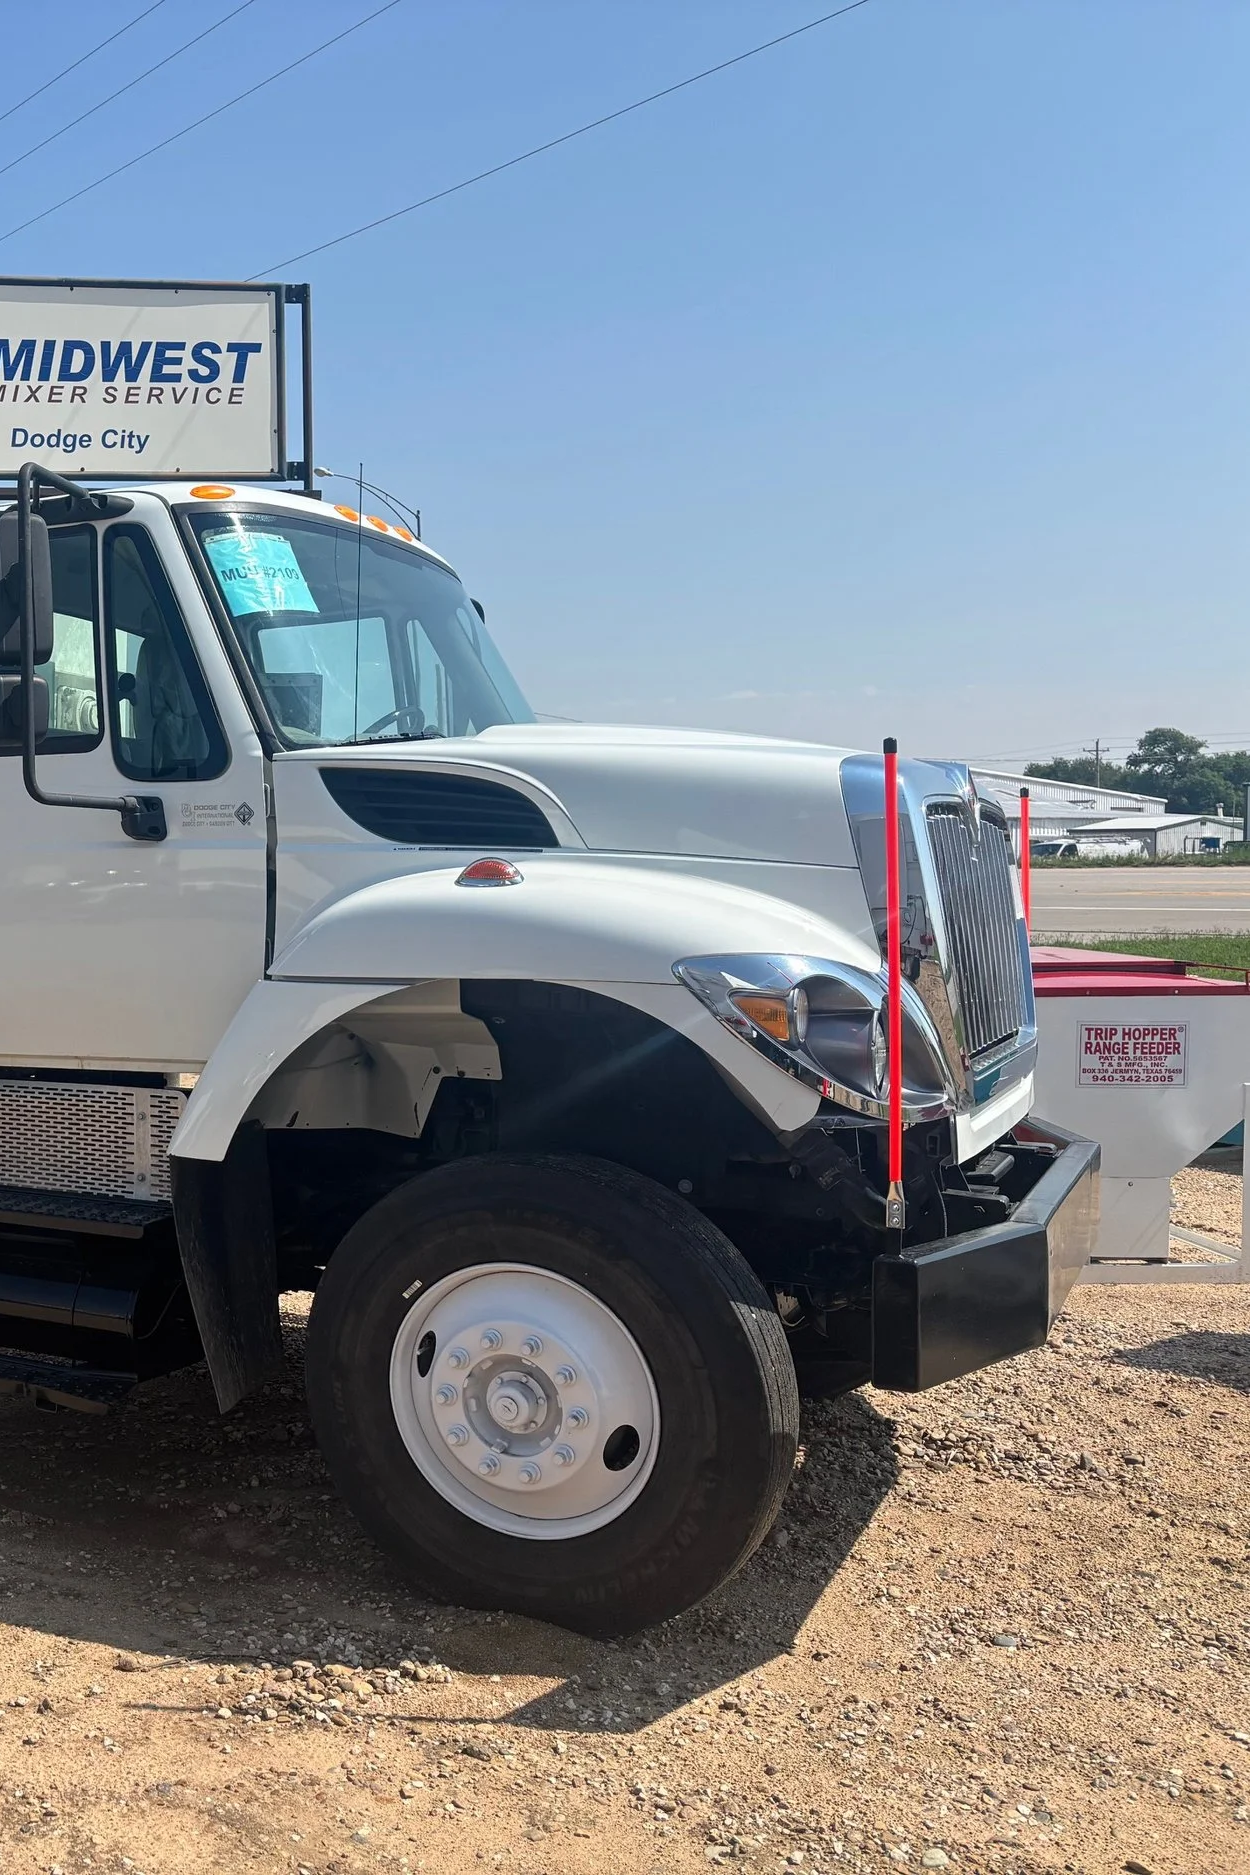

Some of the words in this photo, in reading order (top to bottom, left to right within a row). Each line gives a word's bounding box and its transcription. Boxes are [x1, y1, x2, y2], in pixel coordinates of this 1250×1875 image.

[102, 385, 245, 405] SERVICE
[10, 428, 92, 453] Dodge
[101, 429, 150, 454] City
[1084, 1027, 1118, 1041] TRIP
[1122, 1027, 1178, 1041] HOPPER
[1084, 1042, 1129, 1055] RANGE
[1132, 1042, 1181, 1055] FEEDER
[1091, 1074, 1174, 1083] 940-342-2005
